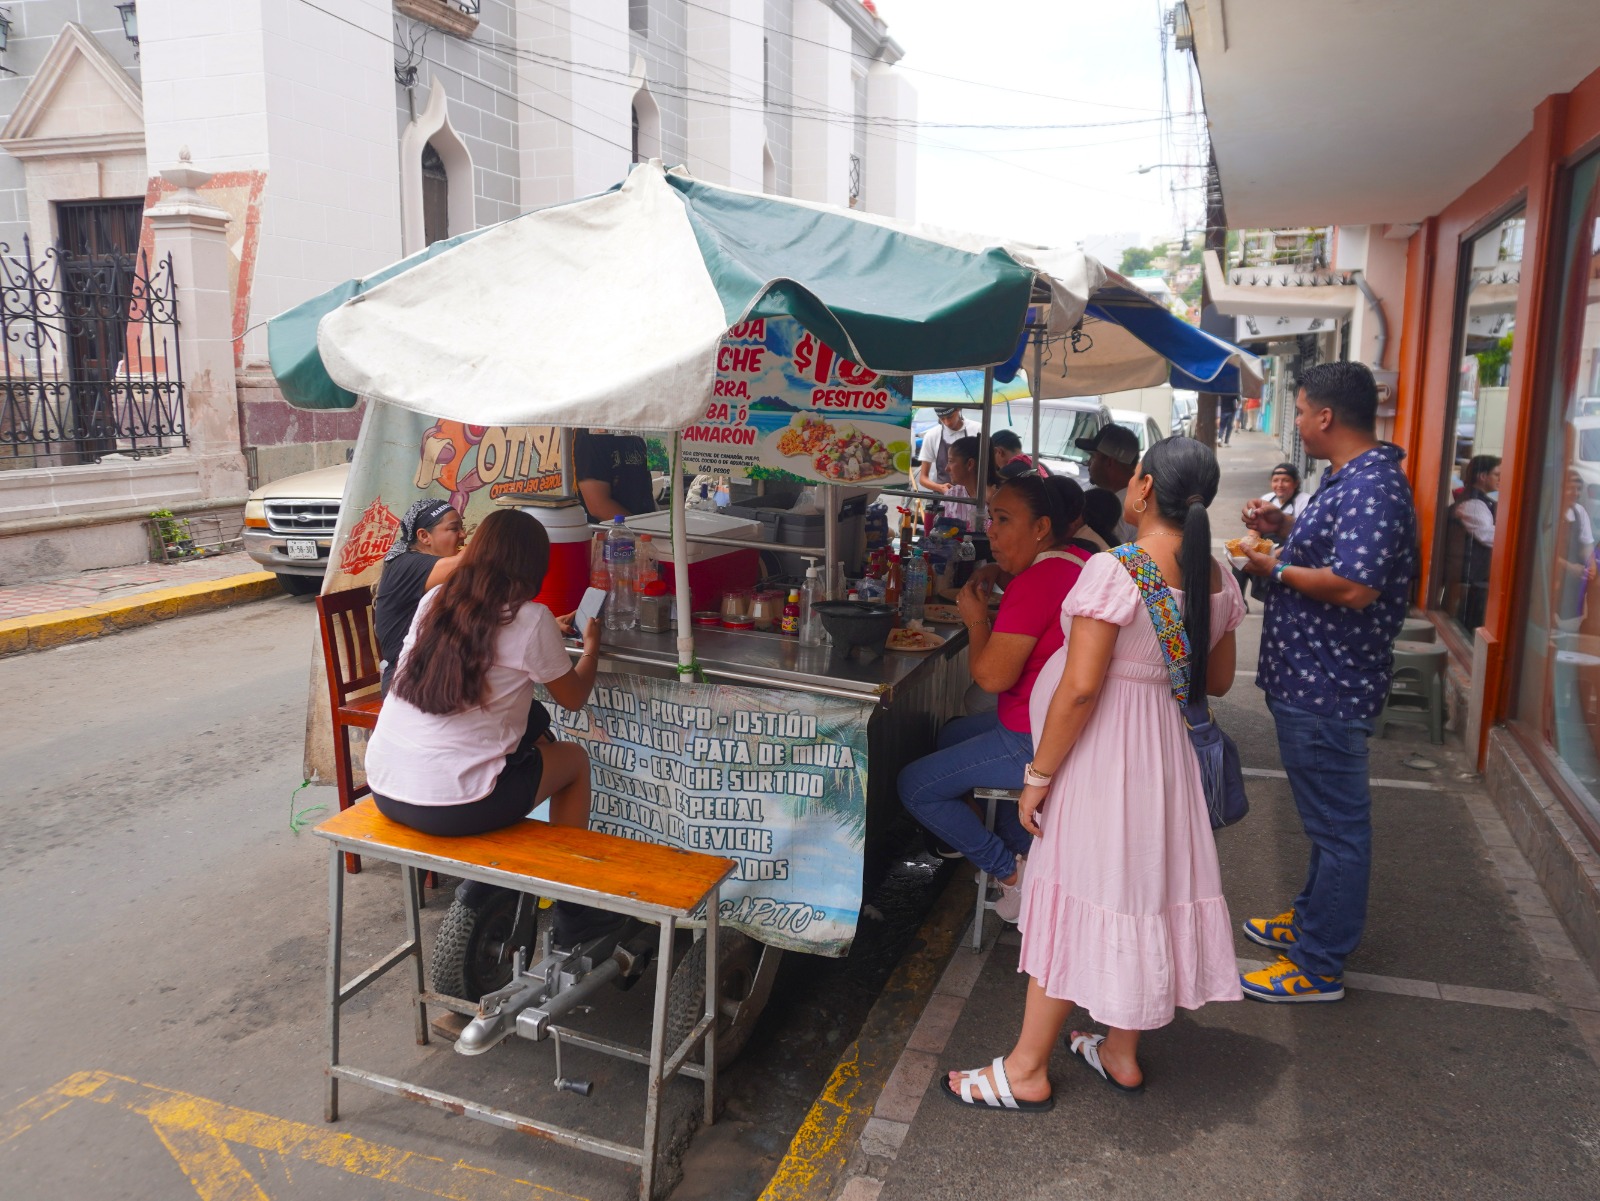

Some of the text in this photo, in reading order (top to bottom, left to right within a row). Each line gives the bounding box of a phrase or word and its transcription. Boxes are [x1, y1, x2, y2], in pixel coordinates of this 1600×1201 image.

[729, 318, 765, 339] DA
[717, 346, 765, 373] CHE
[713, 380, 751, 400] RRA,
[811, 388, 888, 410] PESITOS
[706, 403, 728, 420] BA
[681, 421, 756, 446] AMARÓN
[698, 464, 731, 475] $60 PESOS
[586, 686, 636, 715] ARÓN
[650, 698, 713, 730] PULPO
[733, 709, 818, 739] OSTIÓN
[606, 715, 682, 756] CARACOL
[758, 742, 787, 765] DE
[792, 743, 856, 769] MULA
[651, 755, 723, 790] CEVICHE
[728, 770, 825, 798] SURTIDO
[592, 765, 764, 822] TOSTADA ESPECIAL
[668, 815, 685, 843] DE
[687, 824, 773, 854] CEVICHE
[718, 856, 789, 881] ADOS
